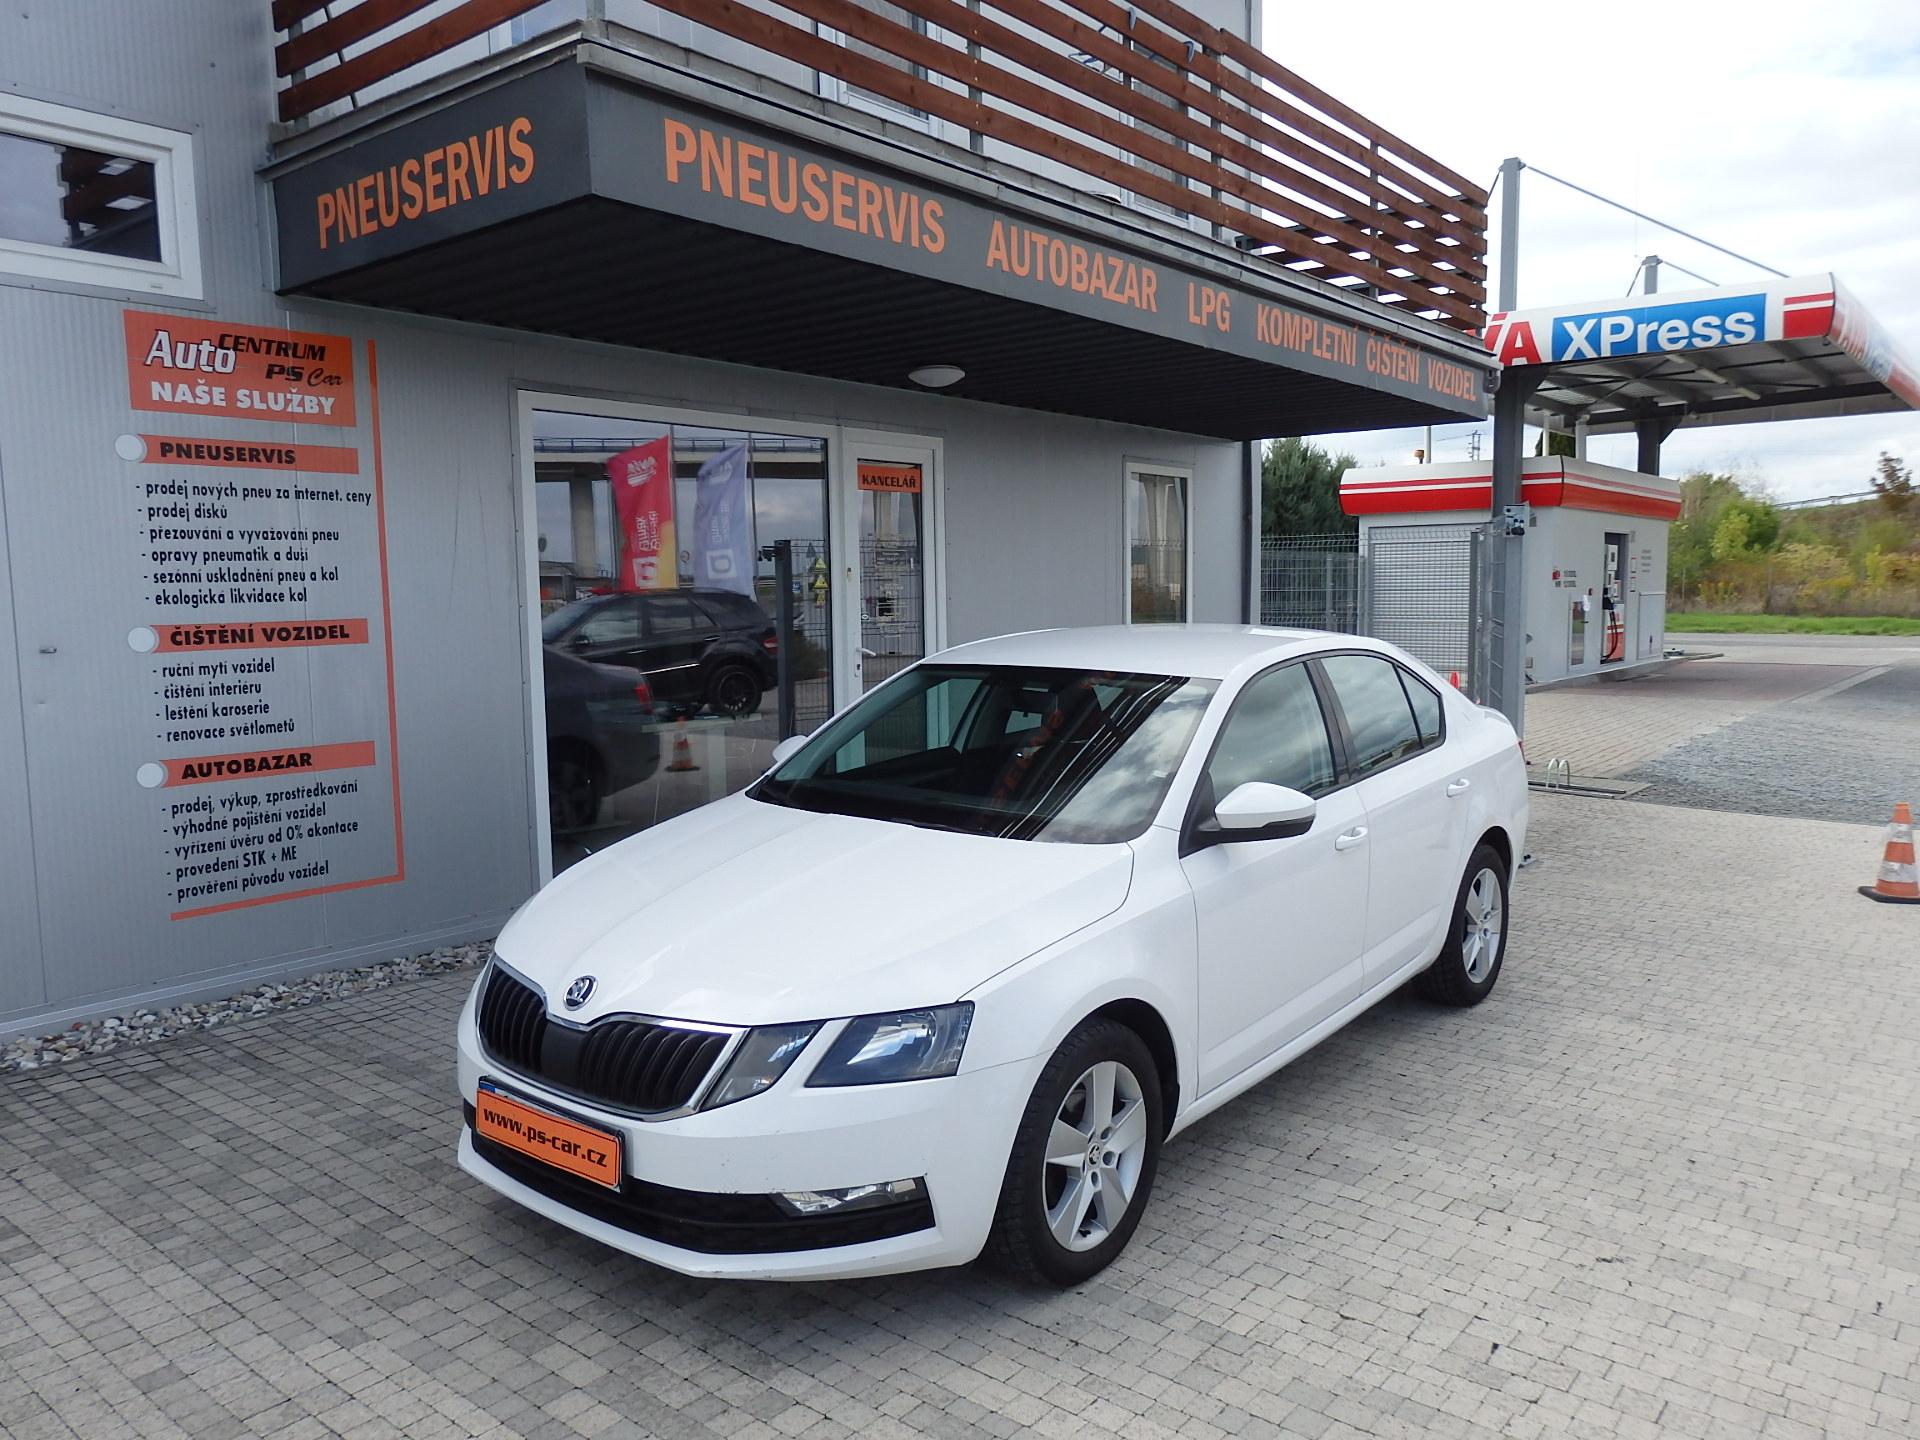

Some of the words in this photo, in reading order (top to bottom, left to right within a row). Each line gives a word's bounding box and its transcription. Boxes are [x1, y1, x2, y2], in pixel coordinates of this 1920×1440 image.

[317, 116, 535, 250] PNEUSERVIS
[664, 118, 945, 254] PNEUSERVIS
[986, 220, 1157, 313] AUTOBAZAR
[1188, 282, 1231, 333] LPG
[1257, 303, 1358, 367] KOMPLETNÍ
[1365, 329, 1421, 385] ČIŠTĚNÍ
[1428, 358, 1476, 402] VOZIDEL
[1561, 311, 1756, 361] XPress
[144, 329, 236, 374] Auto
[218, 333, 326, 362] CENTRUM
[265, 363, 304, 382] PS
[307, 367, 343, 387] Car
[151, 379, 226, 407] NAŠE
[236, 387, 335, 415] SLUŽBY
[160, 442, 296, 465] PNEUSERVIS
[146, 479, 188, 499] prodej
[192, 482, 238, 500] nových
[243, 487, 271, 501] pneu
[276, 488, 289, 499] za
[346, 491, 372, 506] ceny
[862, 473, 916, 489] KANCELÁŘ
[148, 502, 190, 522] prodej
[194, 502, 228, 519] disků
[150, 526, 222, 543] přezouvání
[226, 530, 234, 540] a
[239, 527, 308, 544] vyvažování
[312, 530, 339, 544] pneu
[151, 551, 198, 565] opravy
[203, 546, 269, 565] pneumatik
[274, 550, 281, 561] a
[153, 568, 202, 583] sezónní
[206, 567, 273, 583] uskladnění
[277, 571, 305, 585] pneu
[310, 571, 317, 581] a
[321, 566, 339, 581] kol
[155, 589, 225, 608] ekologická
[230, 588, 285, 604] likvidace
[289, 587, 307, 602] kol
[170, 624, 254, 646] ČIŠTĚNÍ
[261, 625, 350, 642] VOZIDEL
[163, 662, 194, 678] ruční
[199, 661, 228, 678] mytí
[232, 657, 275, 674] vozidel
[164, 683, 205, 699] čištění
[209, 680, 262, 696] interiéru
[165, 704, 208, 721] leštění
[212, 699, 270, 717] karoserie
[167, 727, 225, 743] renovace
[230, 718, 295, 737] světlometů
[181, 752, 312, 780] AUTOBAZAR
[171, 795, 215, 818] prodej,
[220, 792, 261, 812] výkup,
[266, 779, 358, 805] zprostředkování
[173, 819, 228, 839] výhodné
[233, 810, 282, 832] pojištění
[286, 801, 326, 820] vozidel
[175, 838, 226, 860] vyřízení
[230, 834, 264, 849] úvěru
[268, 827, 282, 843] od
[286, 825, 303, 841] 0%
[307, 821, 359, 838] akontace
[176, 856, 239, 882] provedení
[243, 850, 266, 868] STK
[281, 845, 297, 862] ME
[177, 878, 238, 903] prověření
[242, 869, 285, 892] původu
[289, 861, 329, 881] vozidel
[483, 1108, 608, 1168] www.ps-car.cz
